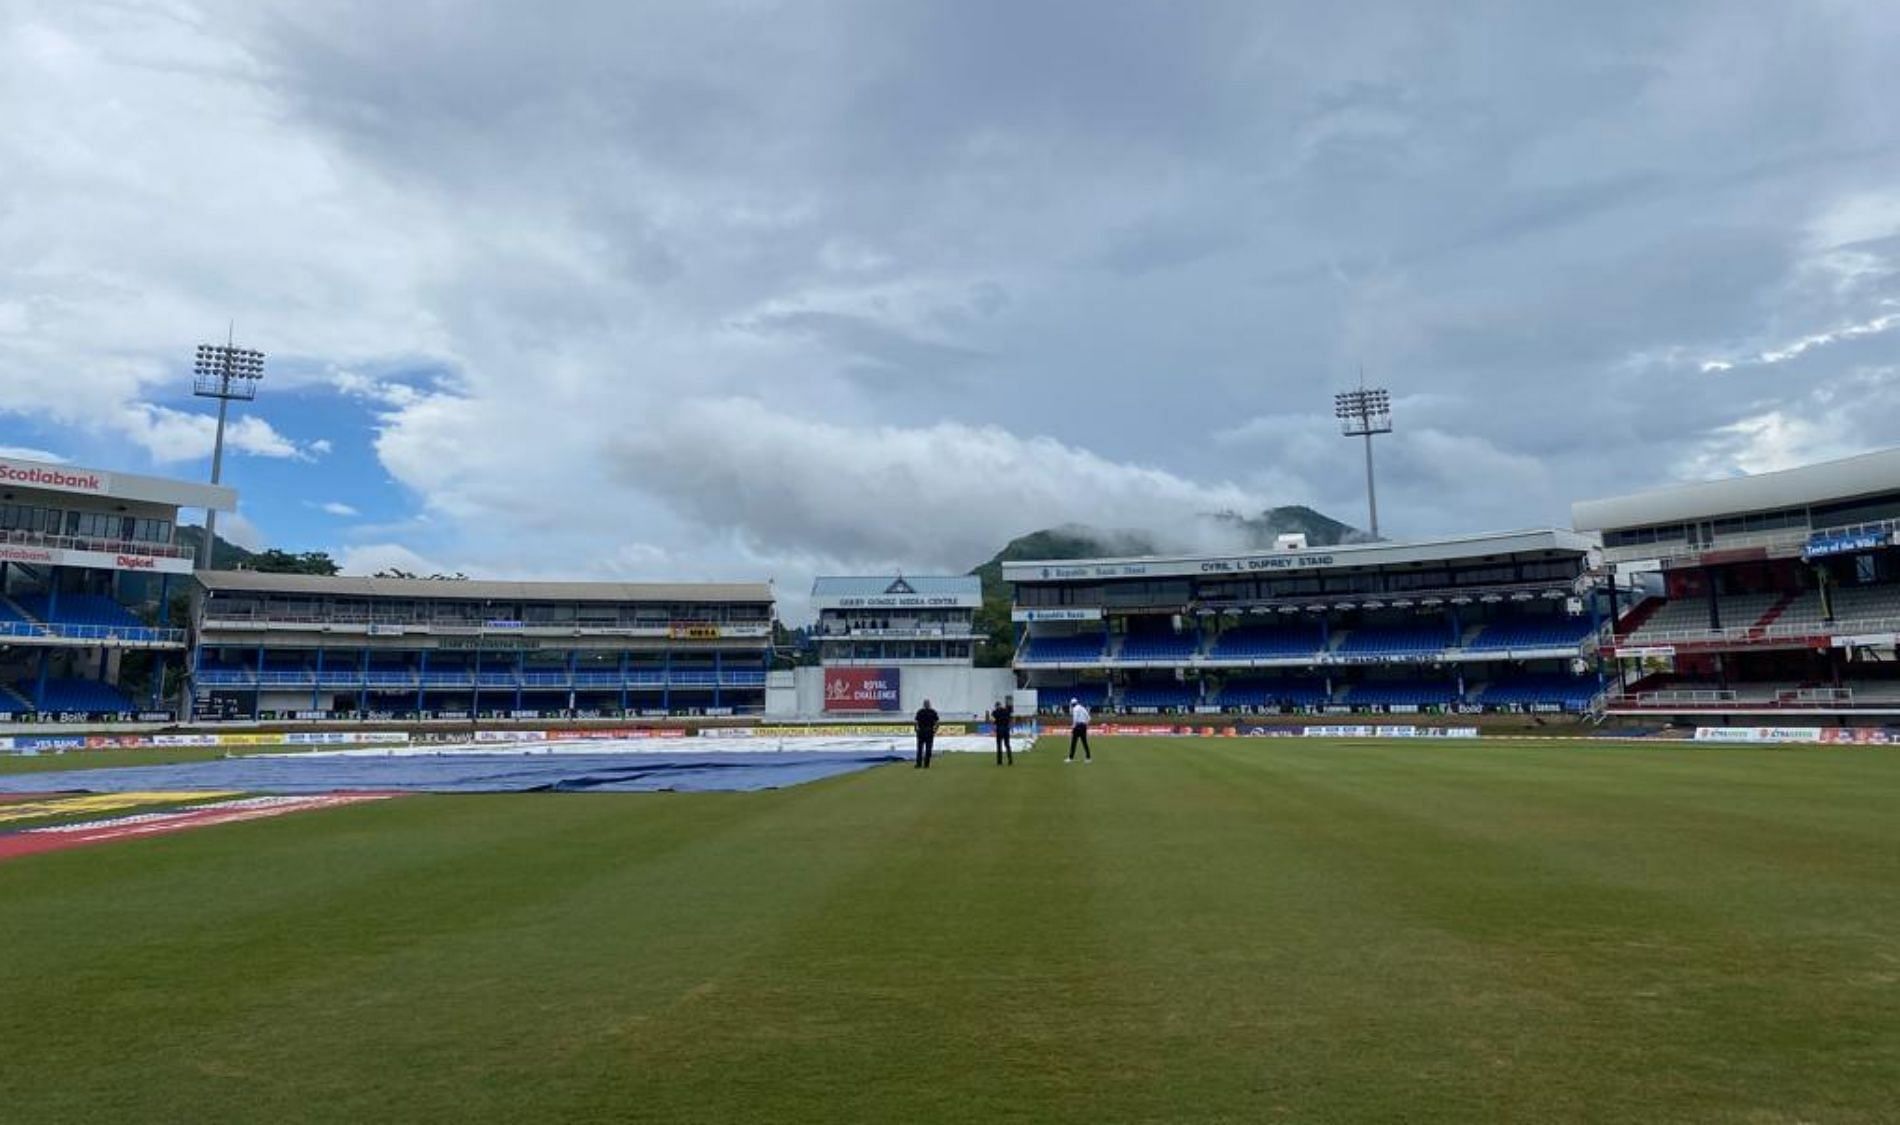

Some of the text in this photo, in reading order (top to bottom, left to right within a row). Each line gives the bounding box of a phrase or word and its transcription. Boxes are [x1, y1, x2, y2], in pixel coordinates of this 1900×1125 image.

[0, 465, 100, 489] Scotiabank
[116, 555, 154, 568] Digicel
[1201, 555, 1333, 572] CYRIL L DUPREY STAND
[863, 680, 887, 689] ROYAL
[854, 690, 897, 700] CHALLENGE
